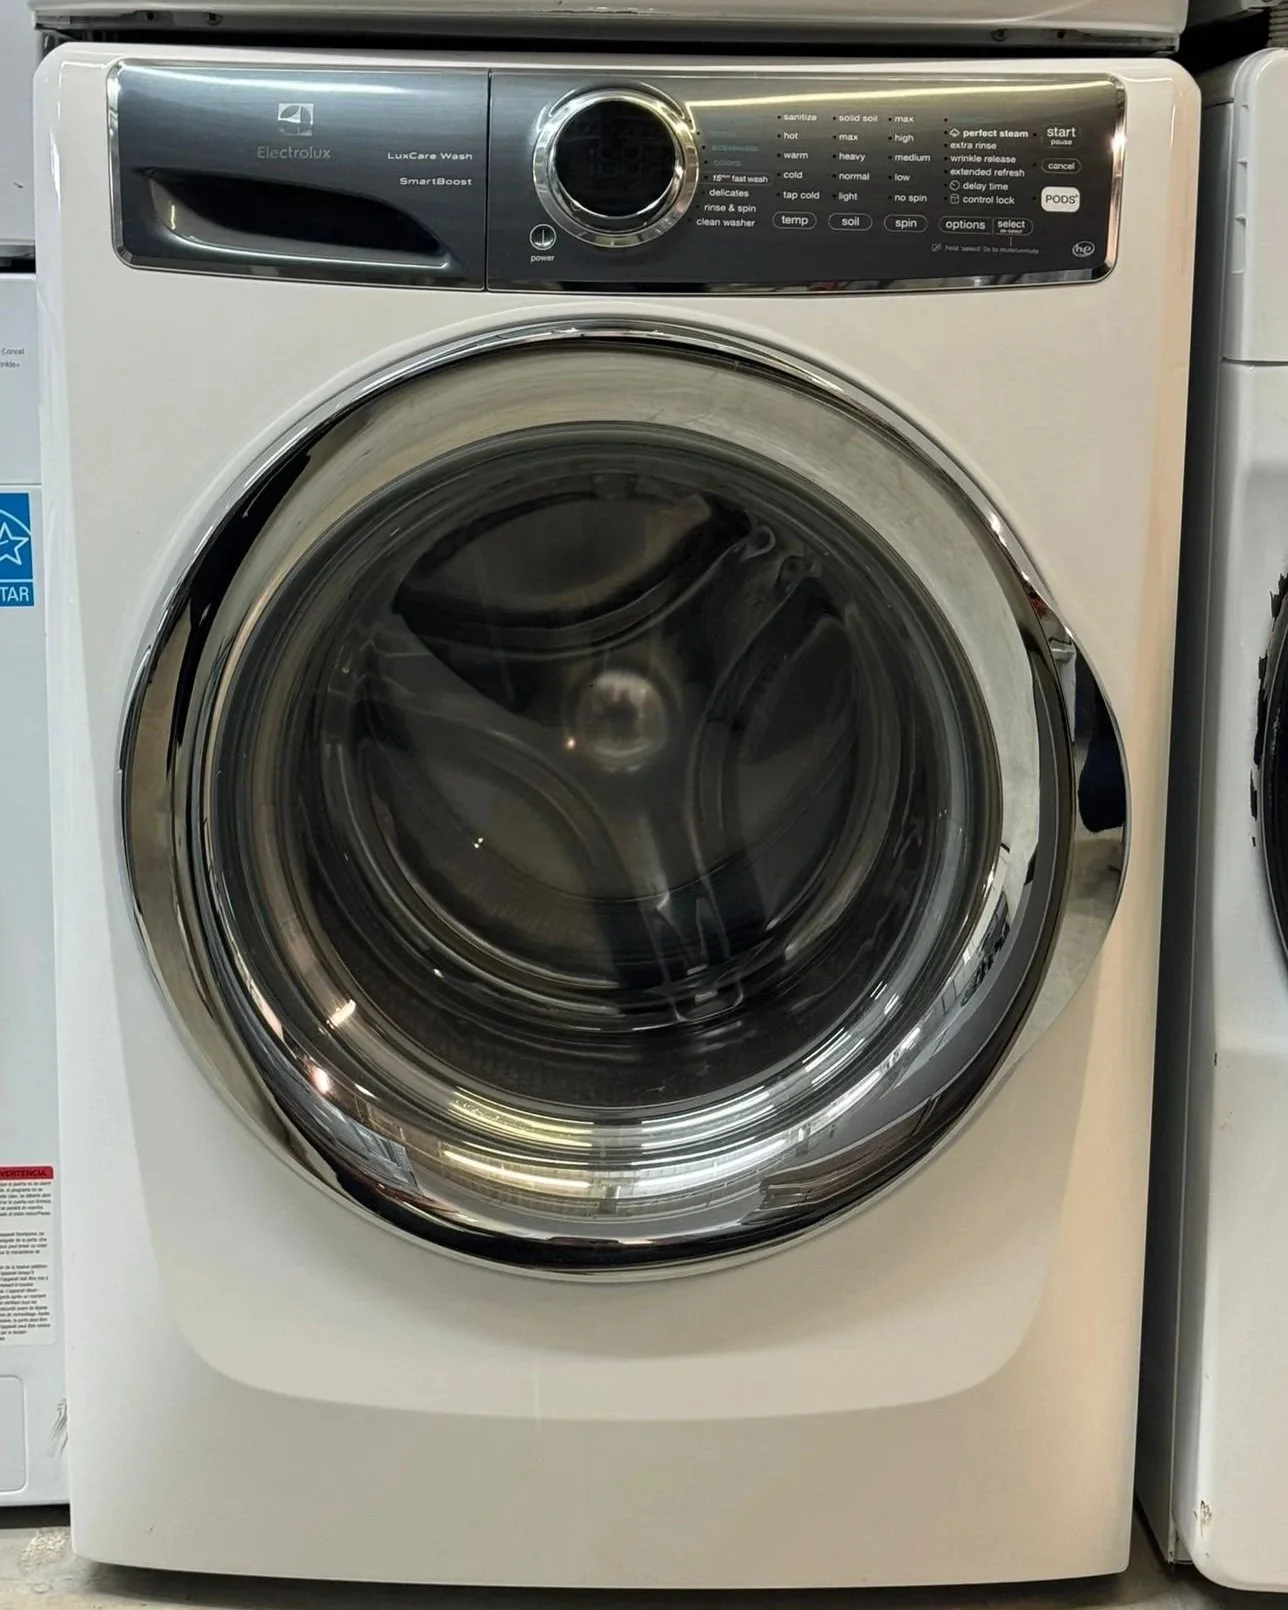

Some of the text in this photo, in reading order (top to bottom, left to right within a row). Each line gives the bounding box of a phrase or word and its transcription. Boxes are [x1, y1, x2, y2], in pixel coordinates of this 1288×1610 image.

[783, 114, 817, 122] sanitize
[783, 132, 799, 140] hot
[962, 128, 1029, 138] perfect steam
[1046, 127, 1076, 138] start
[894, 134, 914, 143] high
[1050, 139, 1073, 147] pause
[950, 141, 997, 150] extra rinse
[257, 146, 332, 159] Electrolux
[387, 151, 473, 160] LuxCare Wash
[838, 153, 866, 162] heavy
[894, 154, 931, 162] medium
[950, 154, 1017, 163] wrinkle release
[713, 159, 741, 167] colors
[1048, 161, 1076, 170] cancel
[783, 171, 803, 179] cold
[838, 172, 870, 181] normal
[894, 173, 911, 181] low
[950, 168, 1025, 177] extended refresh
[399, 177, 473, 186] SmartBoost
[731, 174, 747, 183] fast
[962, 182, 1009, 192] delay time
[708, 188, 750, 197] delicates
[783, 191, 820, 200] tap cold
[838, 192, 858, 201] light
[894, 194, 928, 203] no spin
[962, 195, 1015, 205] control lock
[704, 203, 757, 214] rinse & spin
[696, 217, 756, 227] clean washer
[781, 215, 809, 226] temp
[841, 217, 860, 226] soil
[895, 218, 917, 229] spin
[997, 220, 1026, 229] select
[945, 220, 986, 231] options
[530, 255, 556, 263] power
